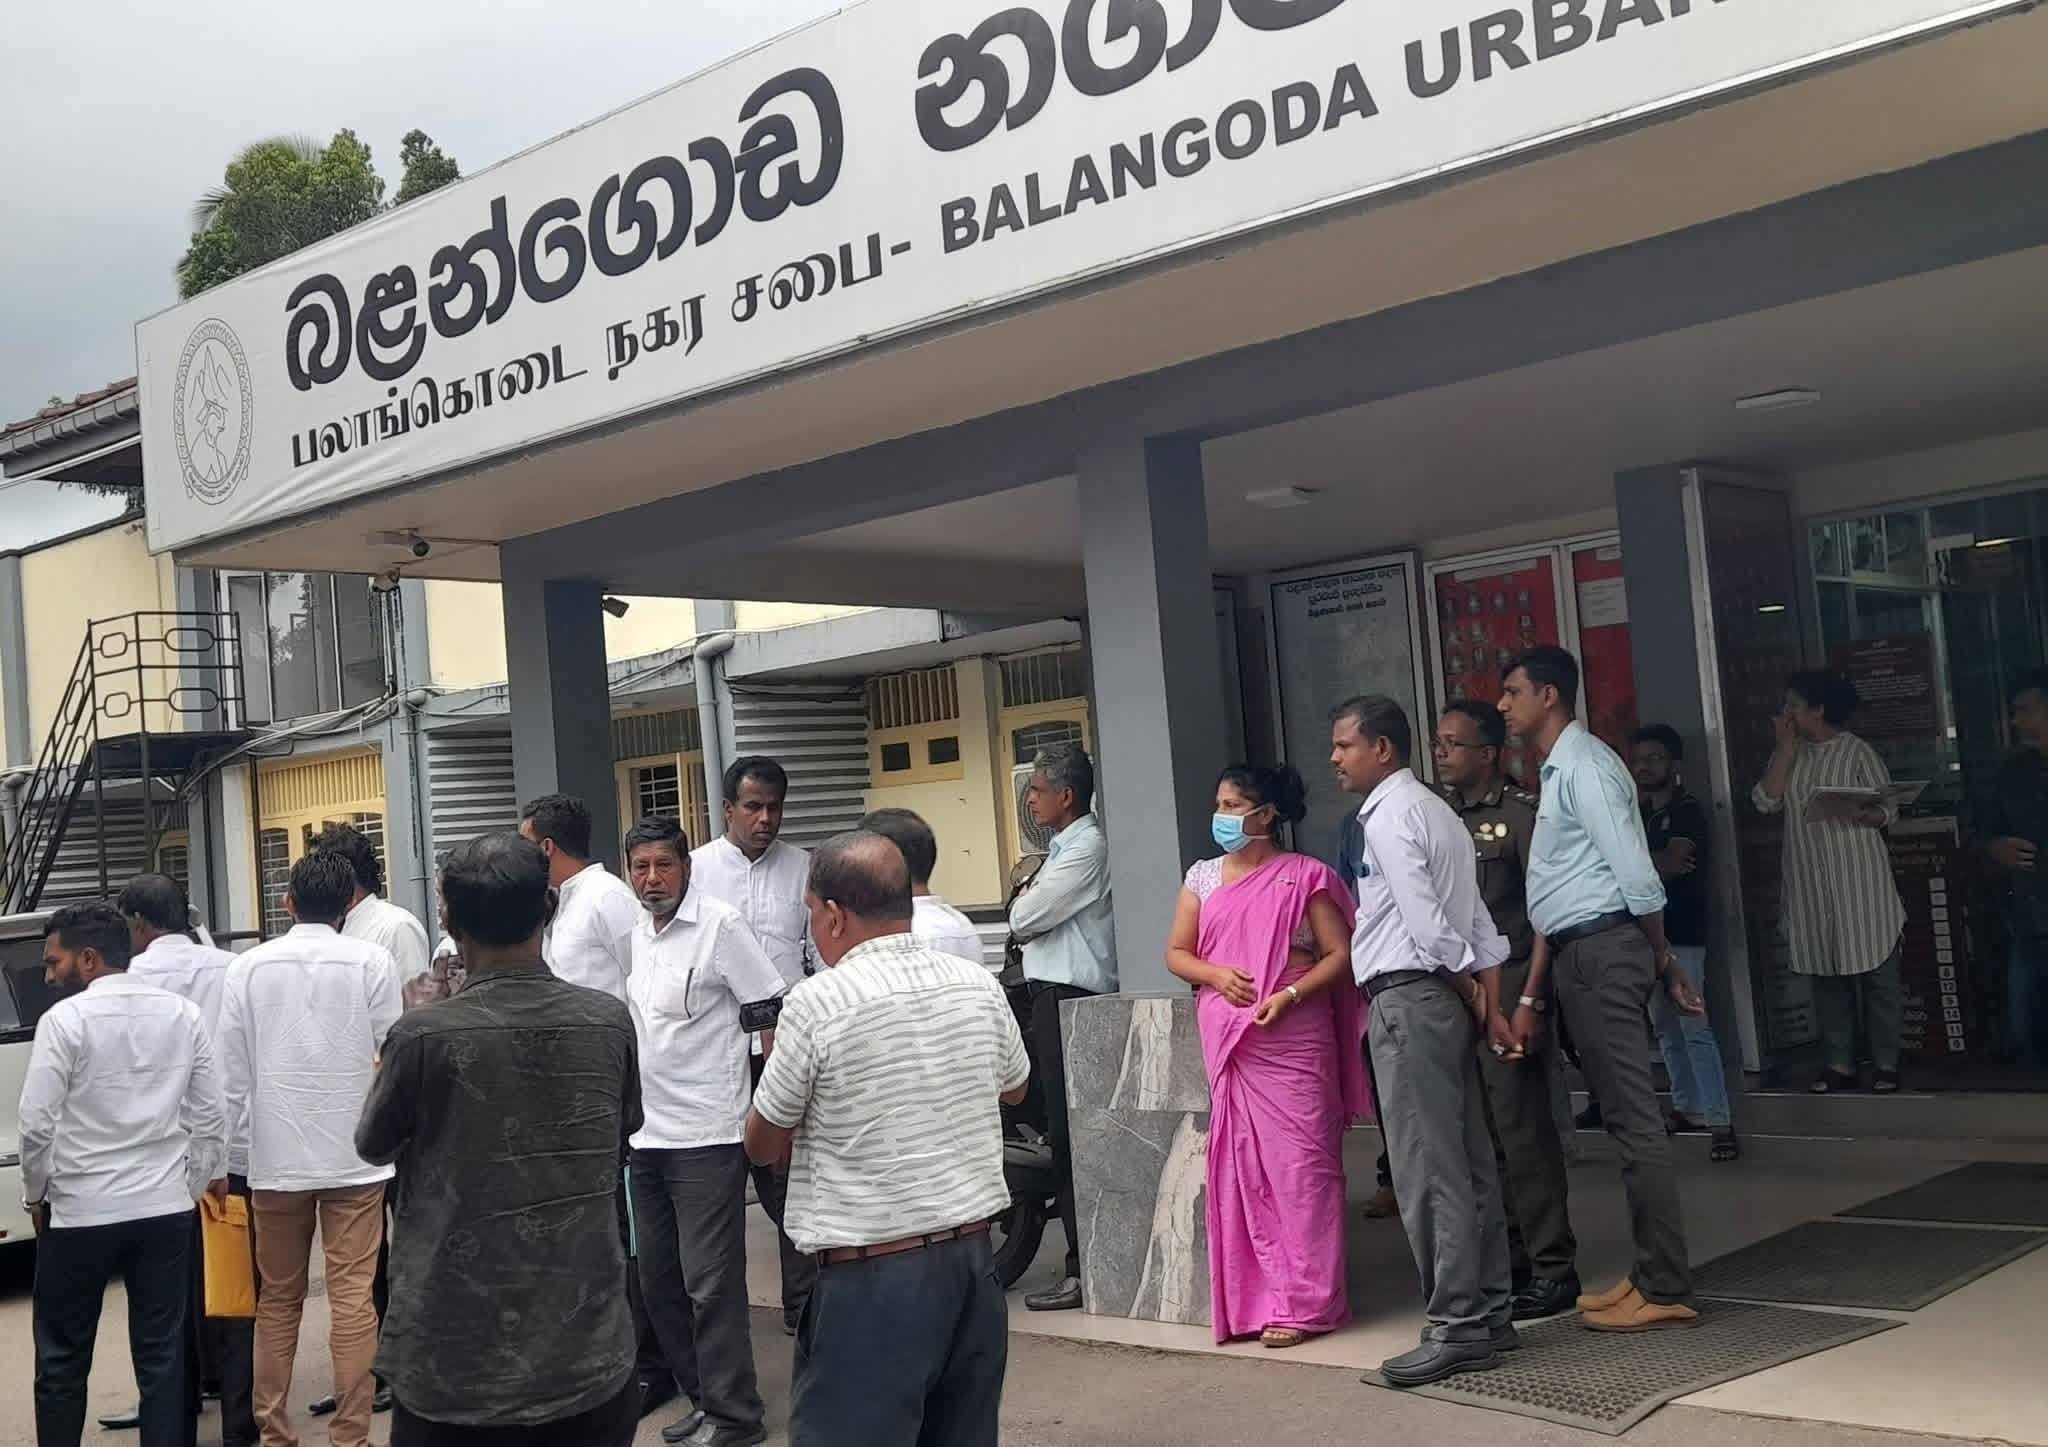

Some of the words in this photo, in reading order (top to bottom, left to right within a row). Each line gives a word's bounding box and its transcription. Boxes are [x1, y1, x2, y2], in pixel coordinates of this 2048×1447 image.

[915, 0, 1345, 153] නග
[291, 344, 588, 468] பலாங்கொடை
[605, 293, 706, 381] நகர
[940, 64, 1379, 254] BALANGODA
[1405, 0, 1728, 99] URBA
